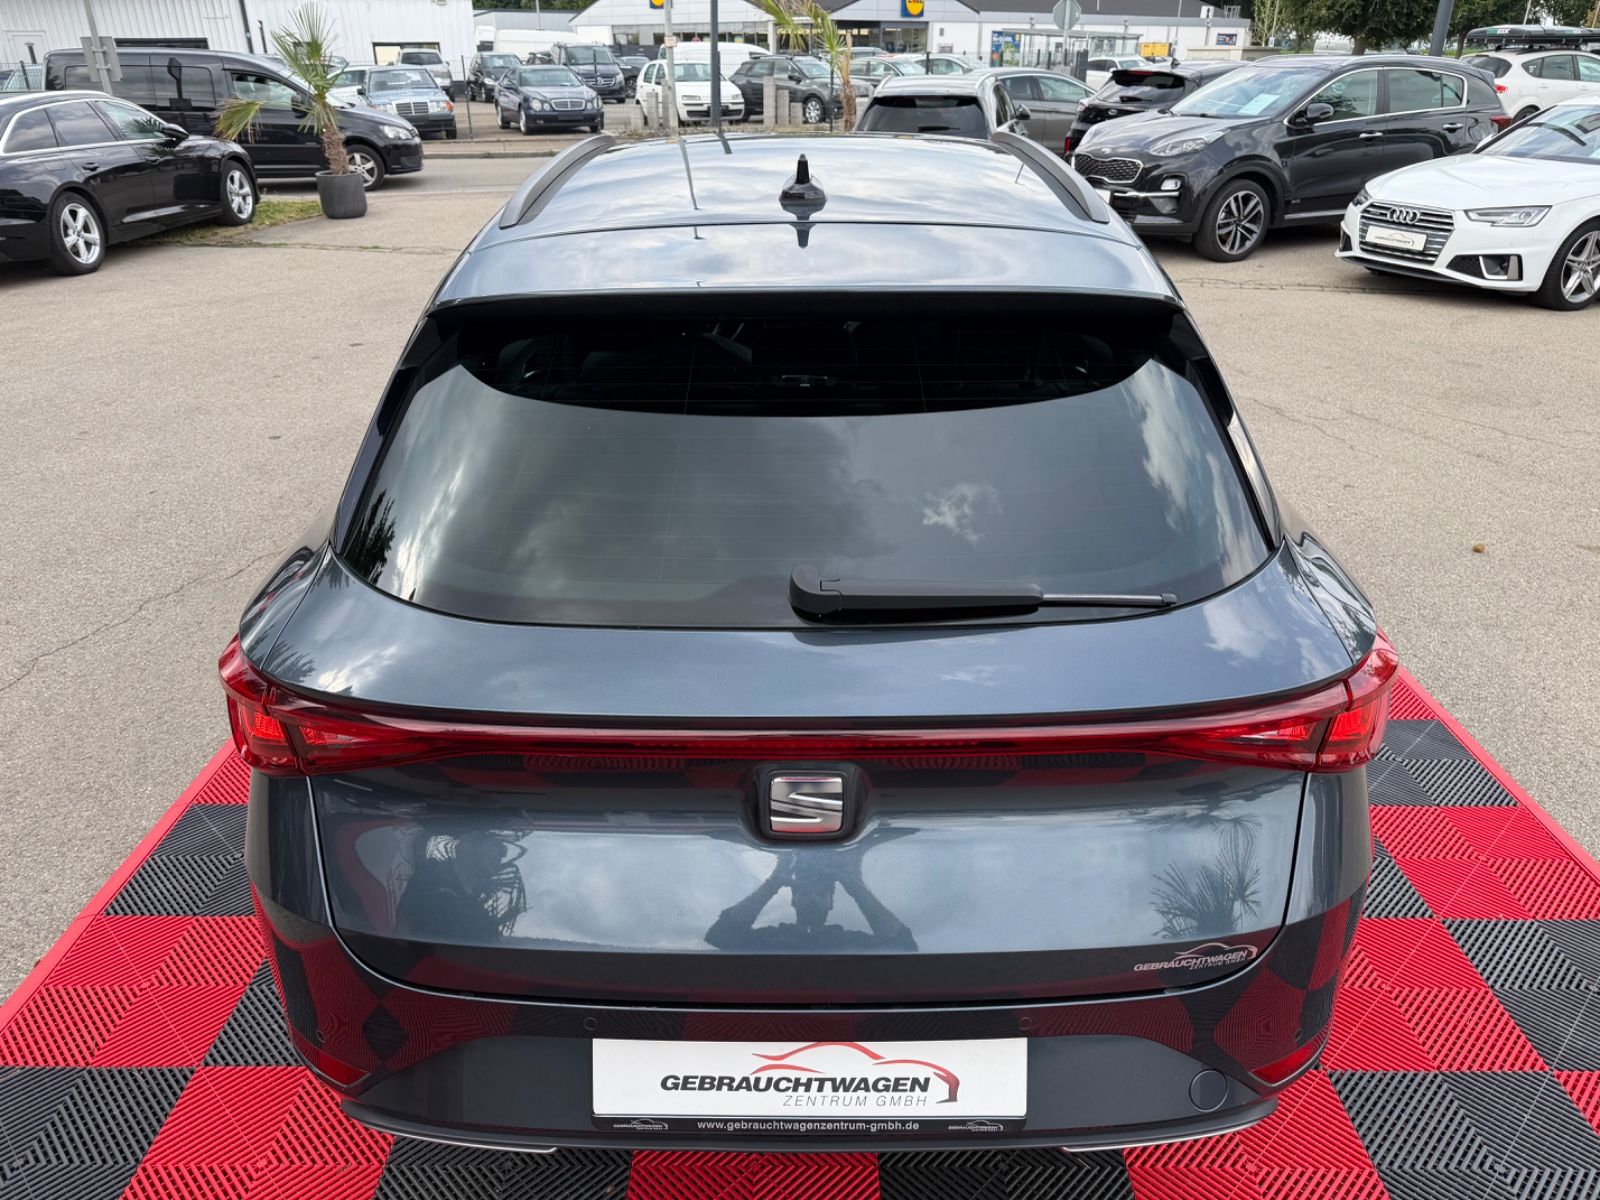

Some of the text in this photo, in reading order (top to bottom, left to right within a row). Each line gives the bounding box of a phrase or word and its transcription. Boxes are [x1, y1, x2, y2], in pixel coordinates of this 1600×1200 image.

[1133, 950, 1248, 971] GEBRAUCHTWAGEN
[660, 1074, 931, 1093] GEBRAUCHTWAGEN
[782, 1095, 928, 1107] ZENTRUM GMBH
[697, 1120, 920, 1131] www.gebrauchtwagenzentrum-gmbh.de
